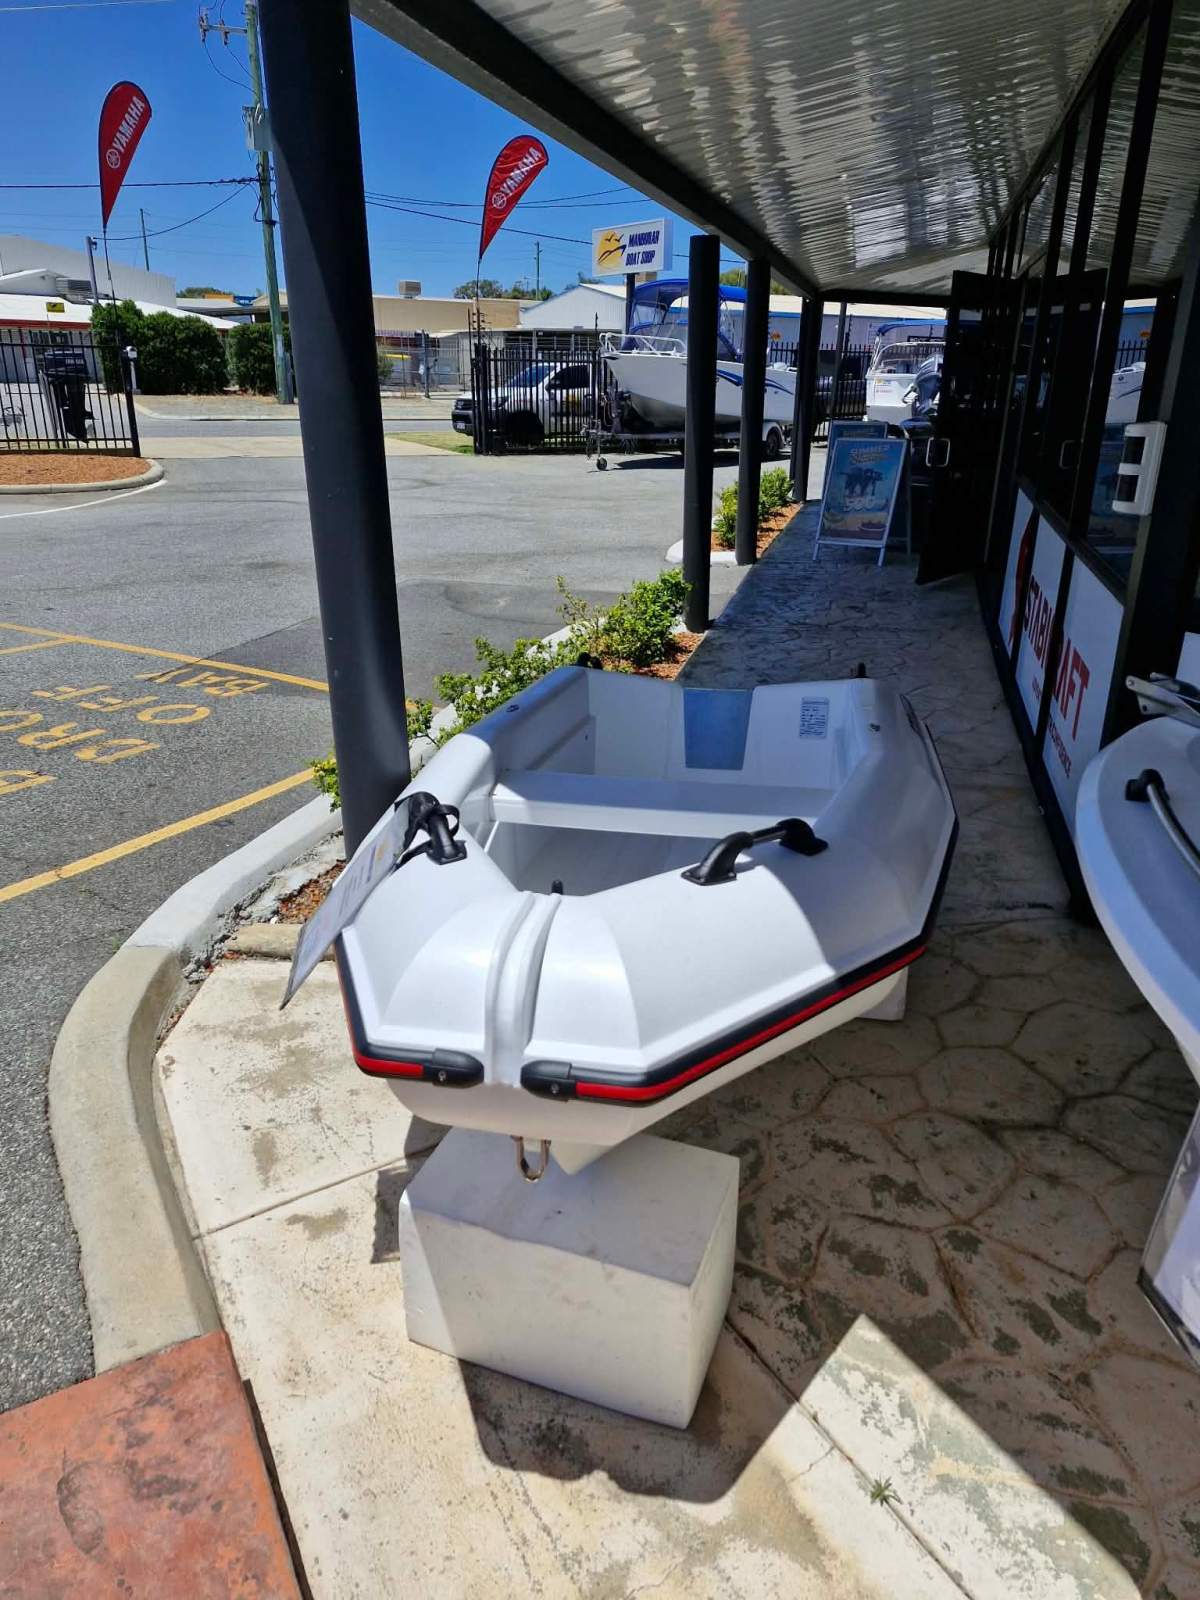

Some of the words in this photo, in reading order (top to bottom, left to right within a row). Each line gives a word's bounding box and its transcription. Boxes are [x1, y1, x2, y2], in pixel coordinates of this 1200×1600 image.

[112, 96, 145, 153] YAMAHA
[500, 147, 541, 196] YAMAHA
[626, 252, 640, 266] BOAT
[133, 667, 271, 698] BAY
